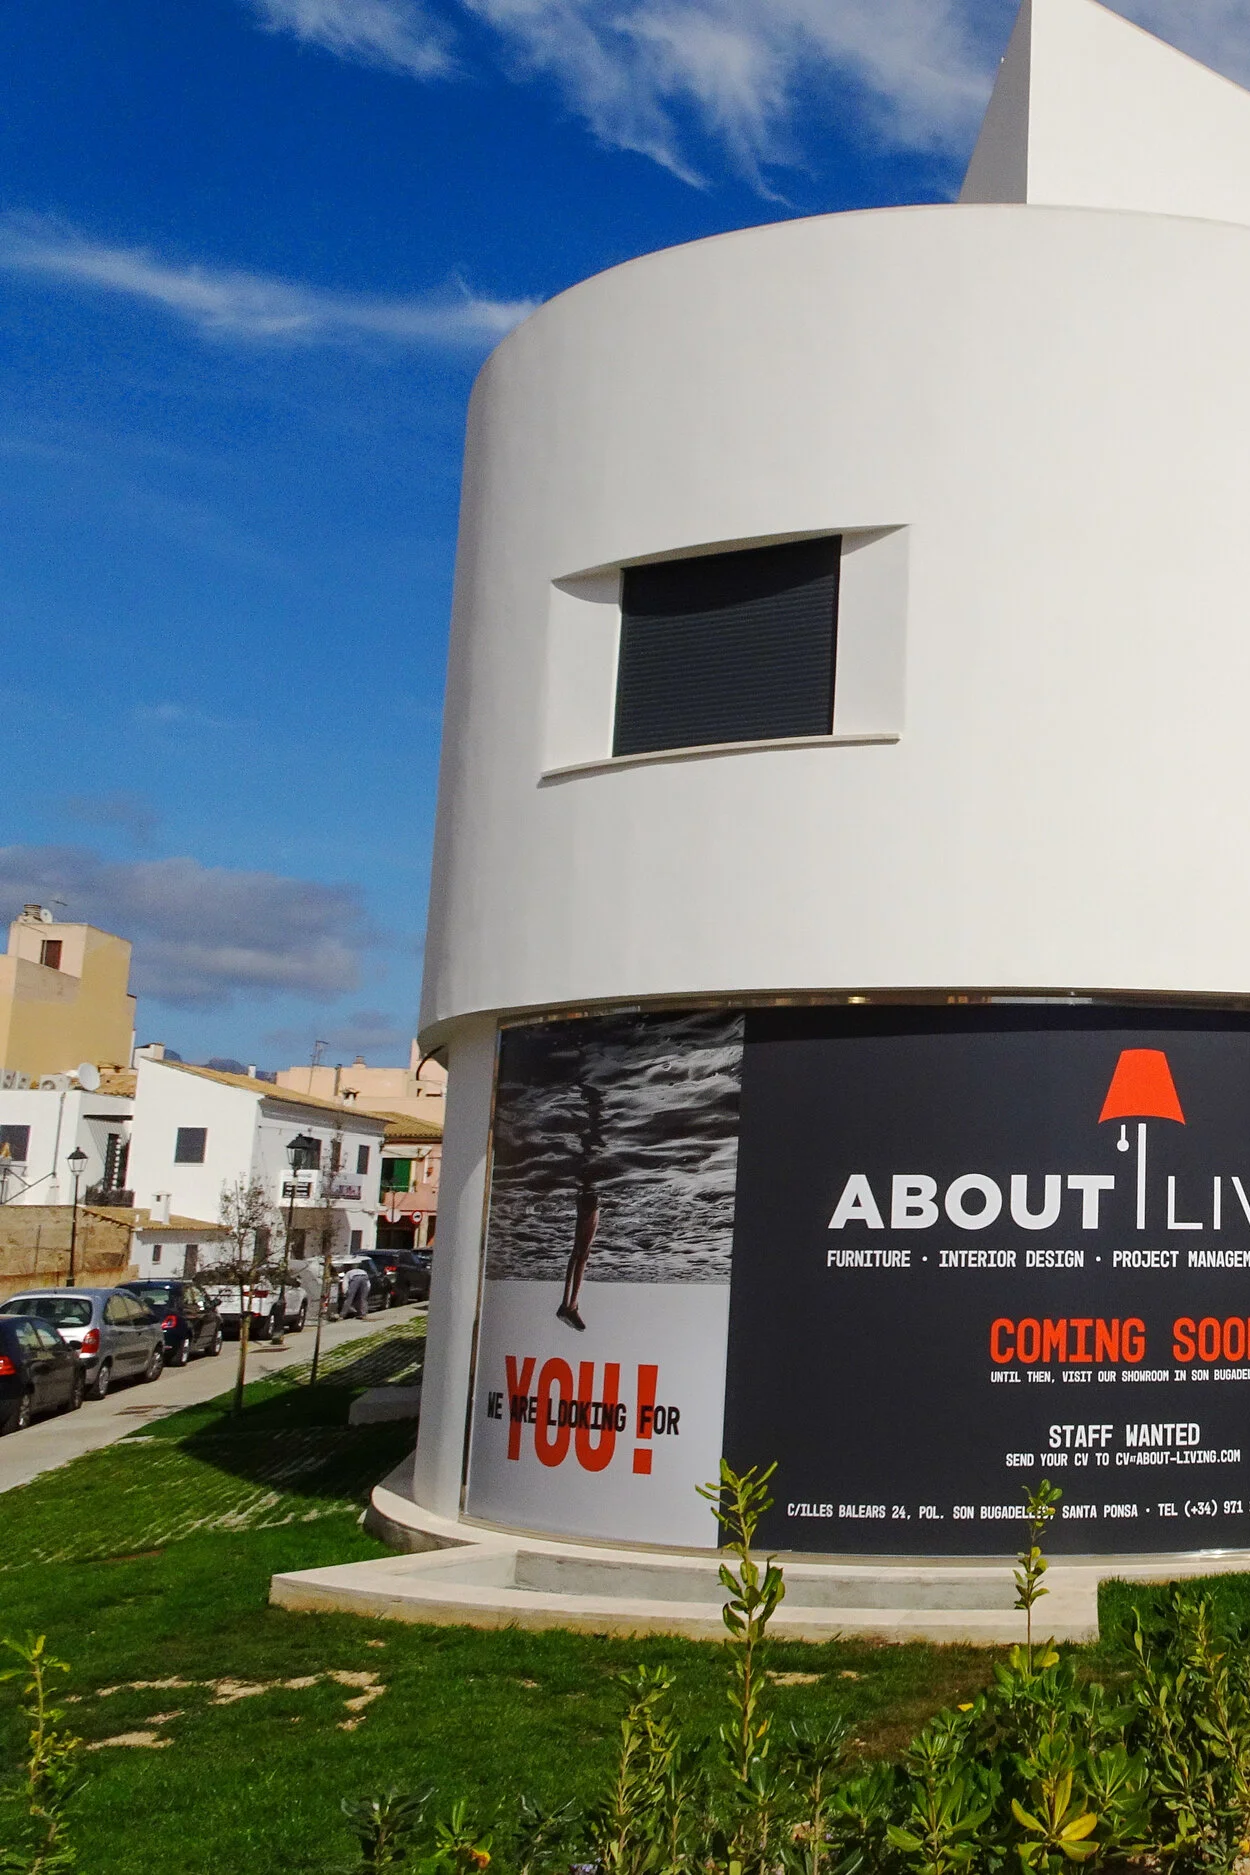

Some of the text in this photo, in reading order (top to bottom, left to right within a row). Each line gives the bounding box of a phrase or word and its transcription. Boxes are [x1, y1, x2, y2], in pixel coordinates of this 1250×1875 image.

[827, 1173, 1115, 1230] ABOUT
[827, 1249, 911, 1268] FURNITURE
[938, 1249, 1016, 1268] INTERIOR
[1025, 1249, 1084, 1268] DESIGN
[1112, 1250, 1179, 1268] PROJECT
[989, 1317, 1146, 1364] COMING
[990, 1371, 1021, 1383] UNTIL
[1027, 1370, 1055, 1384] THEN,
[1062, 1370, 1092, 1383] VISIT
[1098, 1370, 1117, 1383] OUR
[1121, 1369, 1169, 1382] SHOWROOM
[1174, 1369, 1187, 1382] IN
[1191, 1369, 1209, 1381] SON
[487, 1391, 681, 1436] WE ARE LOOKING FOR
[505, 1355, 659, 1475] YOU!
[1049, 1422, 1200, 1449] STAFF WANTED
[1005, 1453, 1034, 1467] SEND
[1040, 1453, 1068, 1467] YOUR
[1074, 1452, 1089, 1466] CV
[1095, 1452, 1109, 1466] TO
[787, 1503, 833, 1518] C/ILLES
[838, 1504, 886, 1519] BALEARS
[891, 1505, 911, 1521] 24,
[918, 1505, 945, 1520] POL.
[952, 1505, 975, 1520] SON
[1062, 1504, 1097, 1519] SANTA
[1103, 1503, 1138, 1518] PONSA
[1157, 1503, 1178, 1517] TEL
[1184, 1499, 1218, 1518] (+34)
[1223, 1500, 1243, 1514] 971
